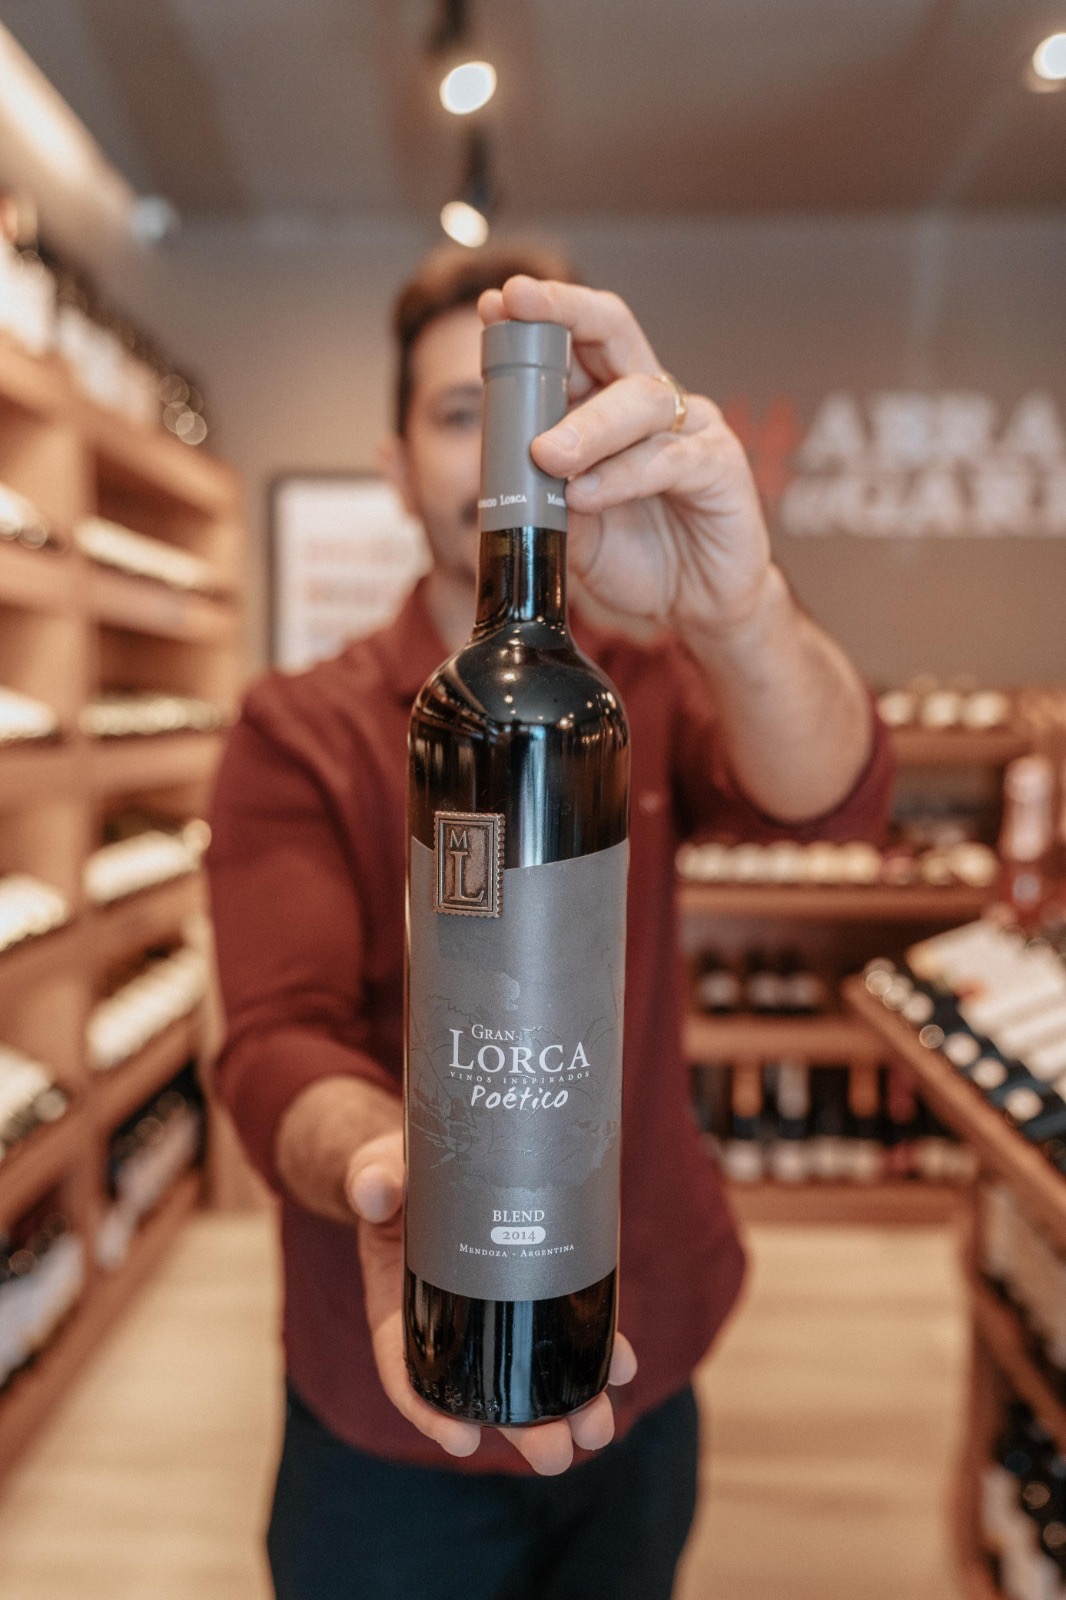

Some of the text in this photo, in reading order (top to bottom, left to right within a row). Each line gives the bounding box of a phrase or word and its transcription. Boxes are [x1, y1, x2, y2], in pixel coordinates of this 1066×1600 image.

[500, 494, 527, 506] LORCA
[449, 829, 468, 849] M
[449, 851, 485, 903] L
[471, 1023, 516, 1041] GRAN
[449, 1028, 591, 1074] LORCA
[450, 1070, 590, 1085] VINOS INSPIRADOS
[470, 1084, 569, 1111] Poético
[492, 1209, 546, 1223] BLEND
[502, 1230, 537, 1243] 2014
[459, 1243, 508, 1258] MENDOZA
[520, 1244, 575, 1258] ARGENTINA
